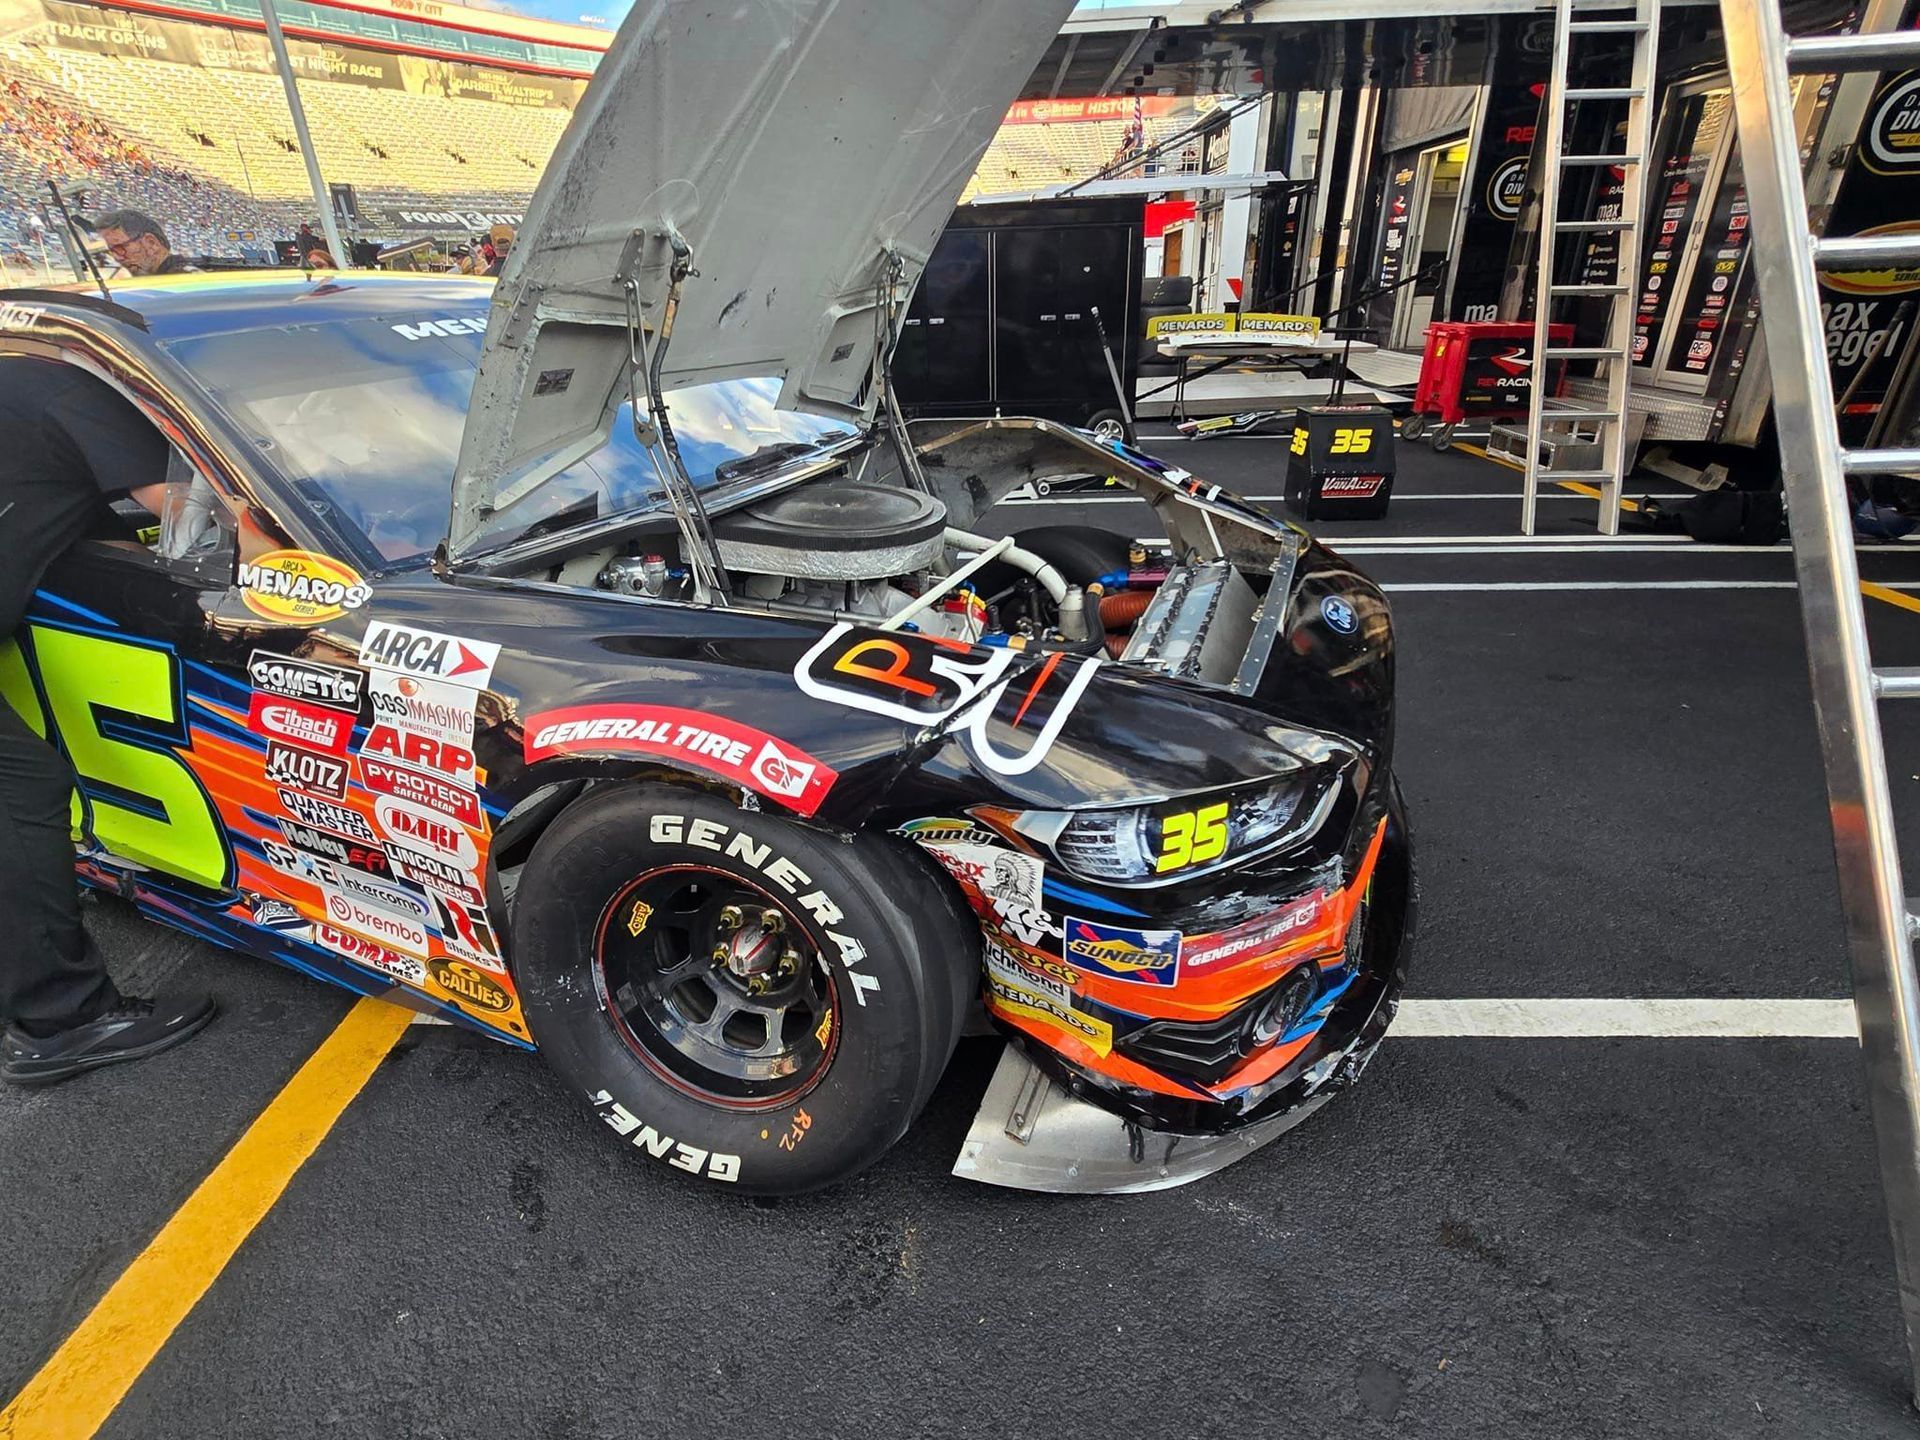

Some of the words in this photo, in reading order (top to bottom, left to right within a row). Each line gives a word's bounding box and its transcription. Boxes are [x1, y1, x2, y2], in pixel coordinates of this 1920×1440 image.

[49, 22, 108, 43] TRACK
[110, 31, 167, 50] OPENS
[308, 58, 347, 73] NIGHT
[349, 63, 382, 79] RACE
[398, 211, 457, 223] FOOD
[487, 213, 524, 224] CITY
[1597, 203, 1620, 219] max
[1731, 217, 1747, 228] 3M
[1157, 318, 1226, 332] MENARDS
[1242, 318, 1314, 333] MENARDS
[1290, 427, 1310, 456] 35
[1330, 428, 1373, 454] 35
[281, 559, 299, 572] ARCA
[237, 563, 365, 609] MENARDS
[292, 604, 317, 616] SERIES
[362, 628, 449, 675] ARCA
[250, 661, 357, 703] COMETIC
[263, 684, 303, 697] GASKET
[261, 706, 337, 740] Eibach
[376, 713, 393, 725] PRINT
[399, 719, 443, 739] MANUFACTURE
[365, 724, 474, 776] ARP
[532, 718, 673, 749] GENERAL
[671, 725, 752, 767] TIRE
[273, 748, 342, 790] KLOTZ
[366, 763, 473, 811] PYROTECT
[393, 785, 430, 804] SAFETY
[430, 797, 455, 815] GEAR
[280, 789, 366, 828] QUARTER
[298, 807, 375, 842] MASTER
[281, 819, 350, 864] Holley
[391, 810, 464, 853] DART
[1156, 803, 1229, 873] 35
[386, 843, 462, 885] LINCOLN
[341, 873, 422, 916] Intercomp
[407, 866, 474, 903] WELDERS
[353, 905, 424, 946] brembo
[633, 904, 648, 929] AERO
[649, 814, 881, 1007] GENERAL
[319, 924, 401, 964] COMP
[445, 939, 492, 967] shocks
[1071, 941, 1169, 968] SUNOCO
[1188, 933, 1262, 966] GENERAL
[373, 959, 414, 980] CAMS
[986, 942, 1066, 997] ichmond
[438, 968, 504, 1009] CALLIES
[991, 978, 1098, 1036] MENARDS
